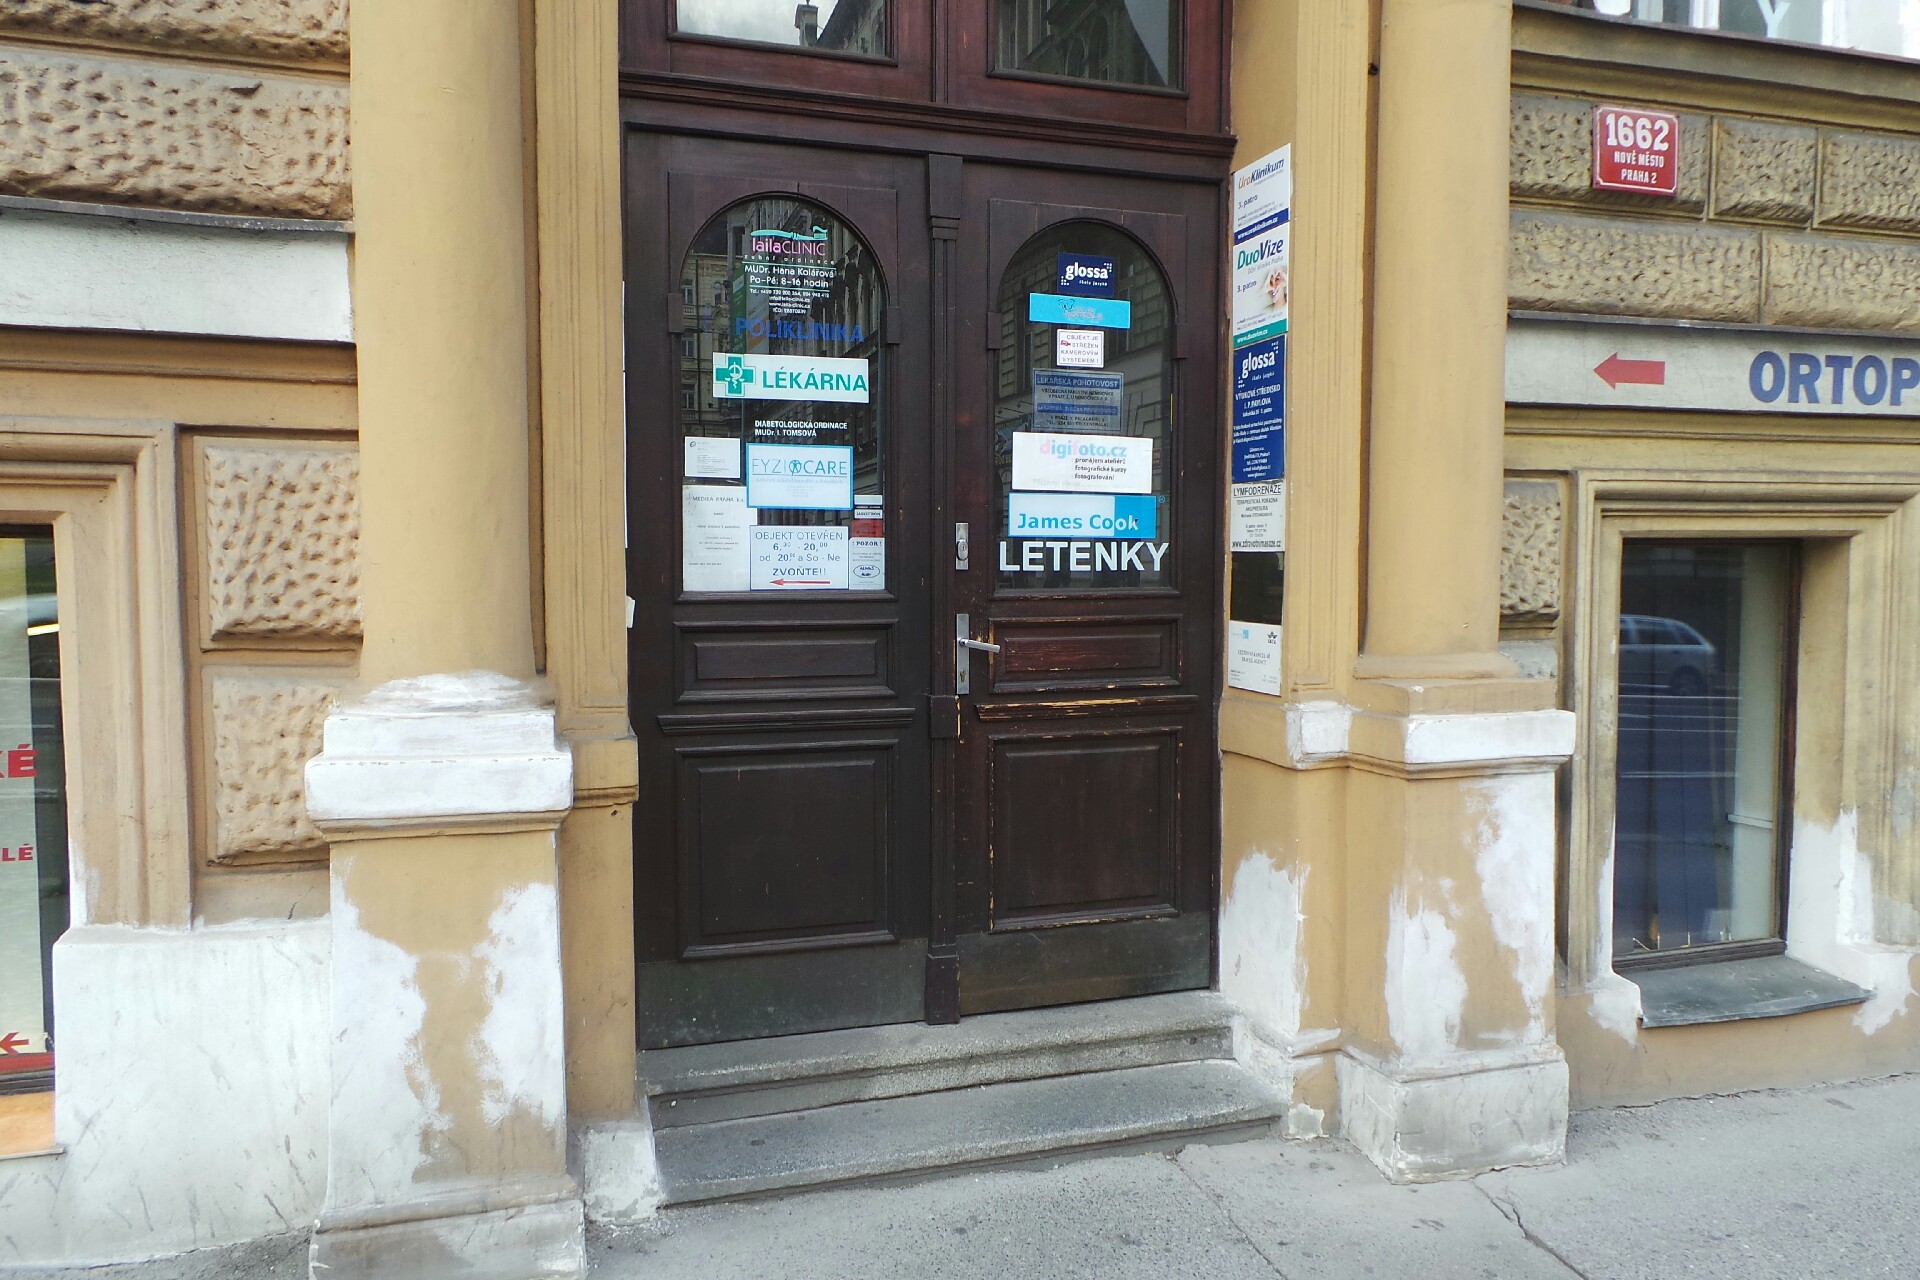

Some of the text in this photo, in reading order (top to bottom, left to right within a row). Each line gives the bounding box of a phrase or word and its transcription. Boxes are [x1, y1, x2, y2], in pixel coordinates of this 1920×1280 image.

[1605, 113, 1669, 151] 1662
[1614, 150, 1665, 168] NOVÉ MĚSTO
[1621, 168, 1657, 184] PRAHA 2
[1237, 239, 1284, 270] DuoVize
[744, 265, 834, 278] MUDr. Hana Kolářová
[1065, 262, 1109, 280] glossa
[803, 278, 829, 288] hodin
[735, 318, 865, 343] POLIKLINIKA
[1241, 351, 1276, 379] glossa
[762, 367, 868, 392] LÉKÁRNA
[1749, 351, 1920, 406] ORTOP
[755, 419, 848, 430] DIABETOLOGICKÁ ORDINACE
[755, 428, 775, 436] MUDr.
[1039, 439, 1127, 459] digifoto.cz
[1074, 465, 1127, 476] fotografické kurzy
[1017, 513, 1139, 531] James Cook
[755, 529, 843, 541] OBJEKT OTEVŘEN
[759, 554, 771, 562] od
[806, 553, 819, 562] So
[827, 553, 841, 562] Ne
[999, 541, 1169, 572] LETENKY
[0, 743, 37, 778] É
